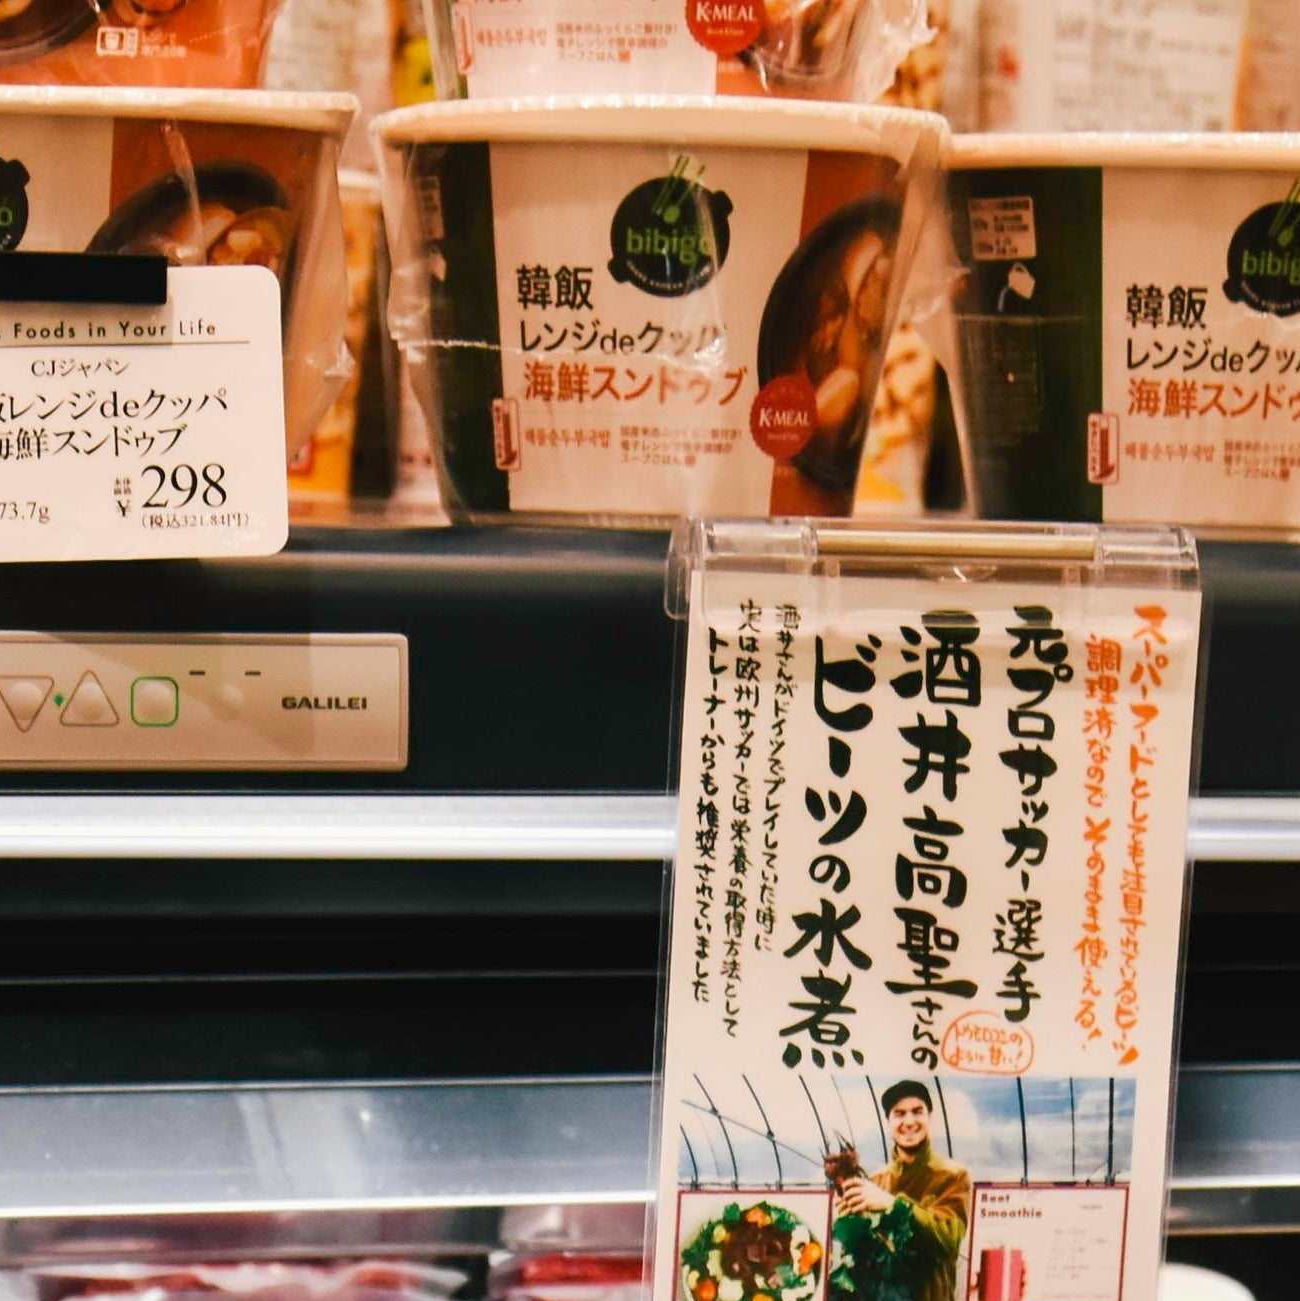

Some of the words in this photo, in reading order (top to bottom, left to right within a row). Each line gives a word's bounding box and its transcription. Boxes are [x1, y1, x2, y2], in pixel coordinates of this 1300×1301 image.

[515, 264, 594, 311] 韓飯
[1126, 284, 1209, 330] 韓飯
[13, 321, 76, 339] Foods
[87, 321, 106, 338] in
[119, 320, 168, 338] Your
[178, 318, 217, 338] Life
[29, 356, 129, 378] CJジャパン
[523, 361, 748, 406] 海鮮スンドゥブ
[141, 463, 228, 509] 298
[280, 695, 368, 711] GALILEI
[991, 604, 1075, 1023] 元プロサッカー選手
[778, 633, 883, 1069] ビーツの水煮
[979, 1206, 1044, 1220] Smoothie
